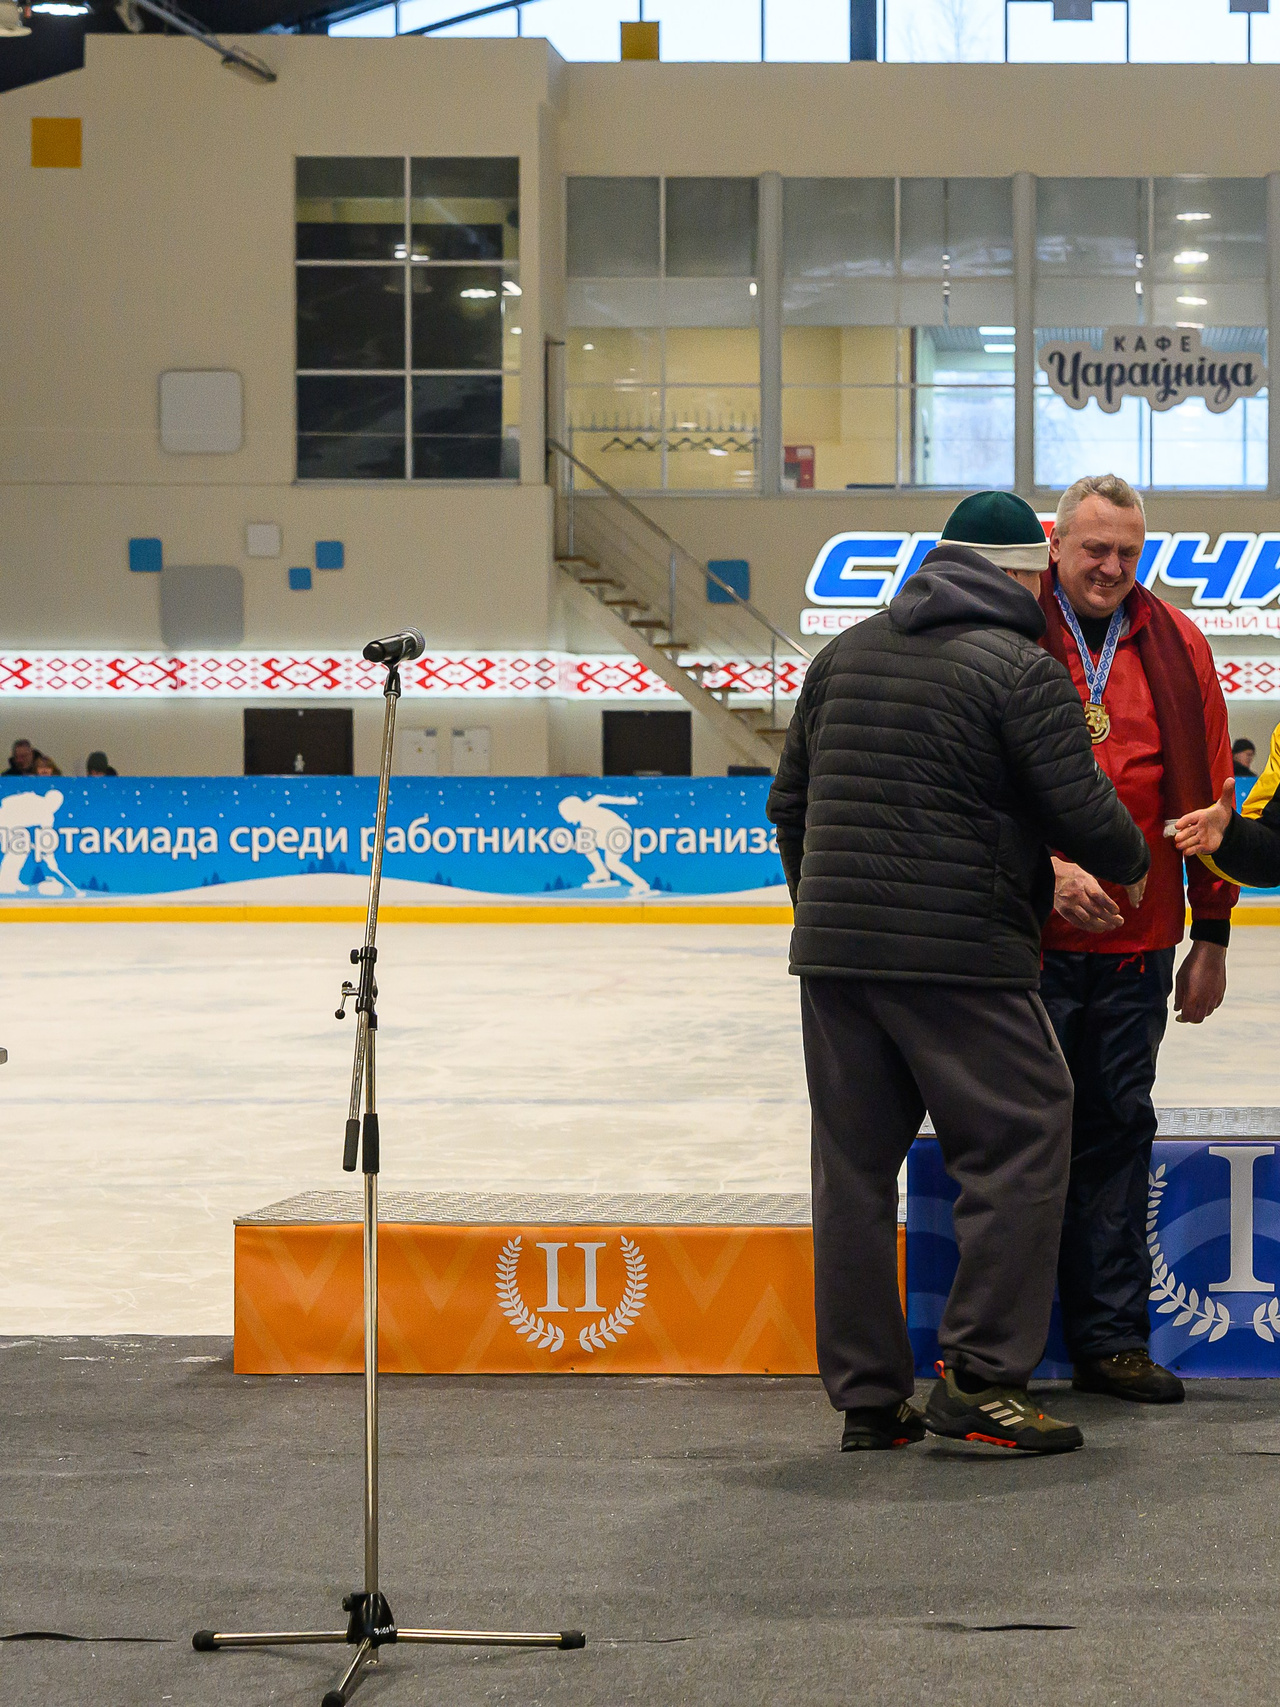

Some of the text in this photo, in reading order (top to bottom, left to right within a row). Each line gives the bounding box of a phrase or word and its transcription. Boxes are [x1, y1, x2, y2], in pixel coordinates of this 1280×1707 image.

[1113, 335, 1191, 353] КАФЕ
[229, 826, 348, 862] среди
[360, 816, 597, 862] работников
[1208, 1146, 1275, 1292] I
[535, 1242, 607, 1312] II
